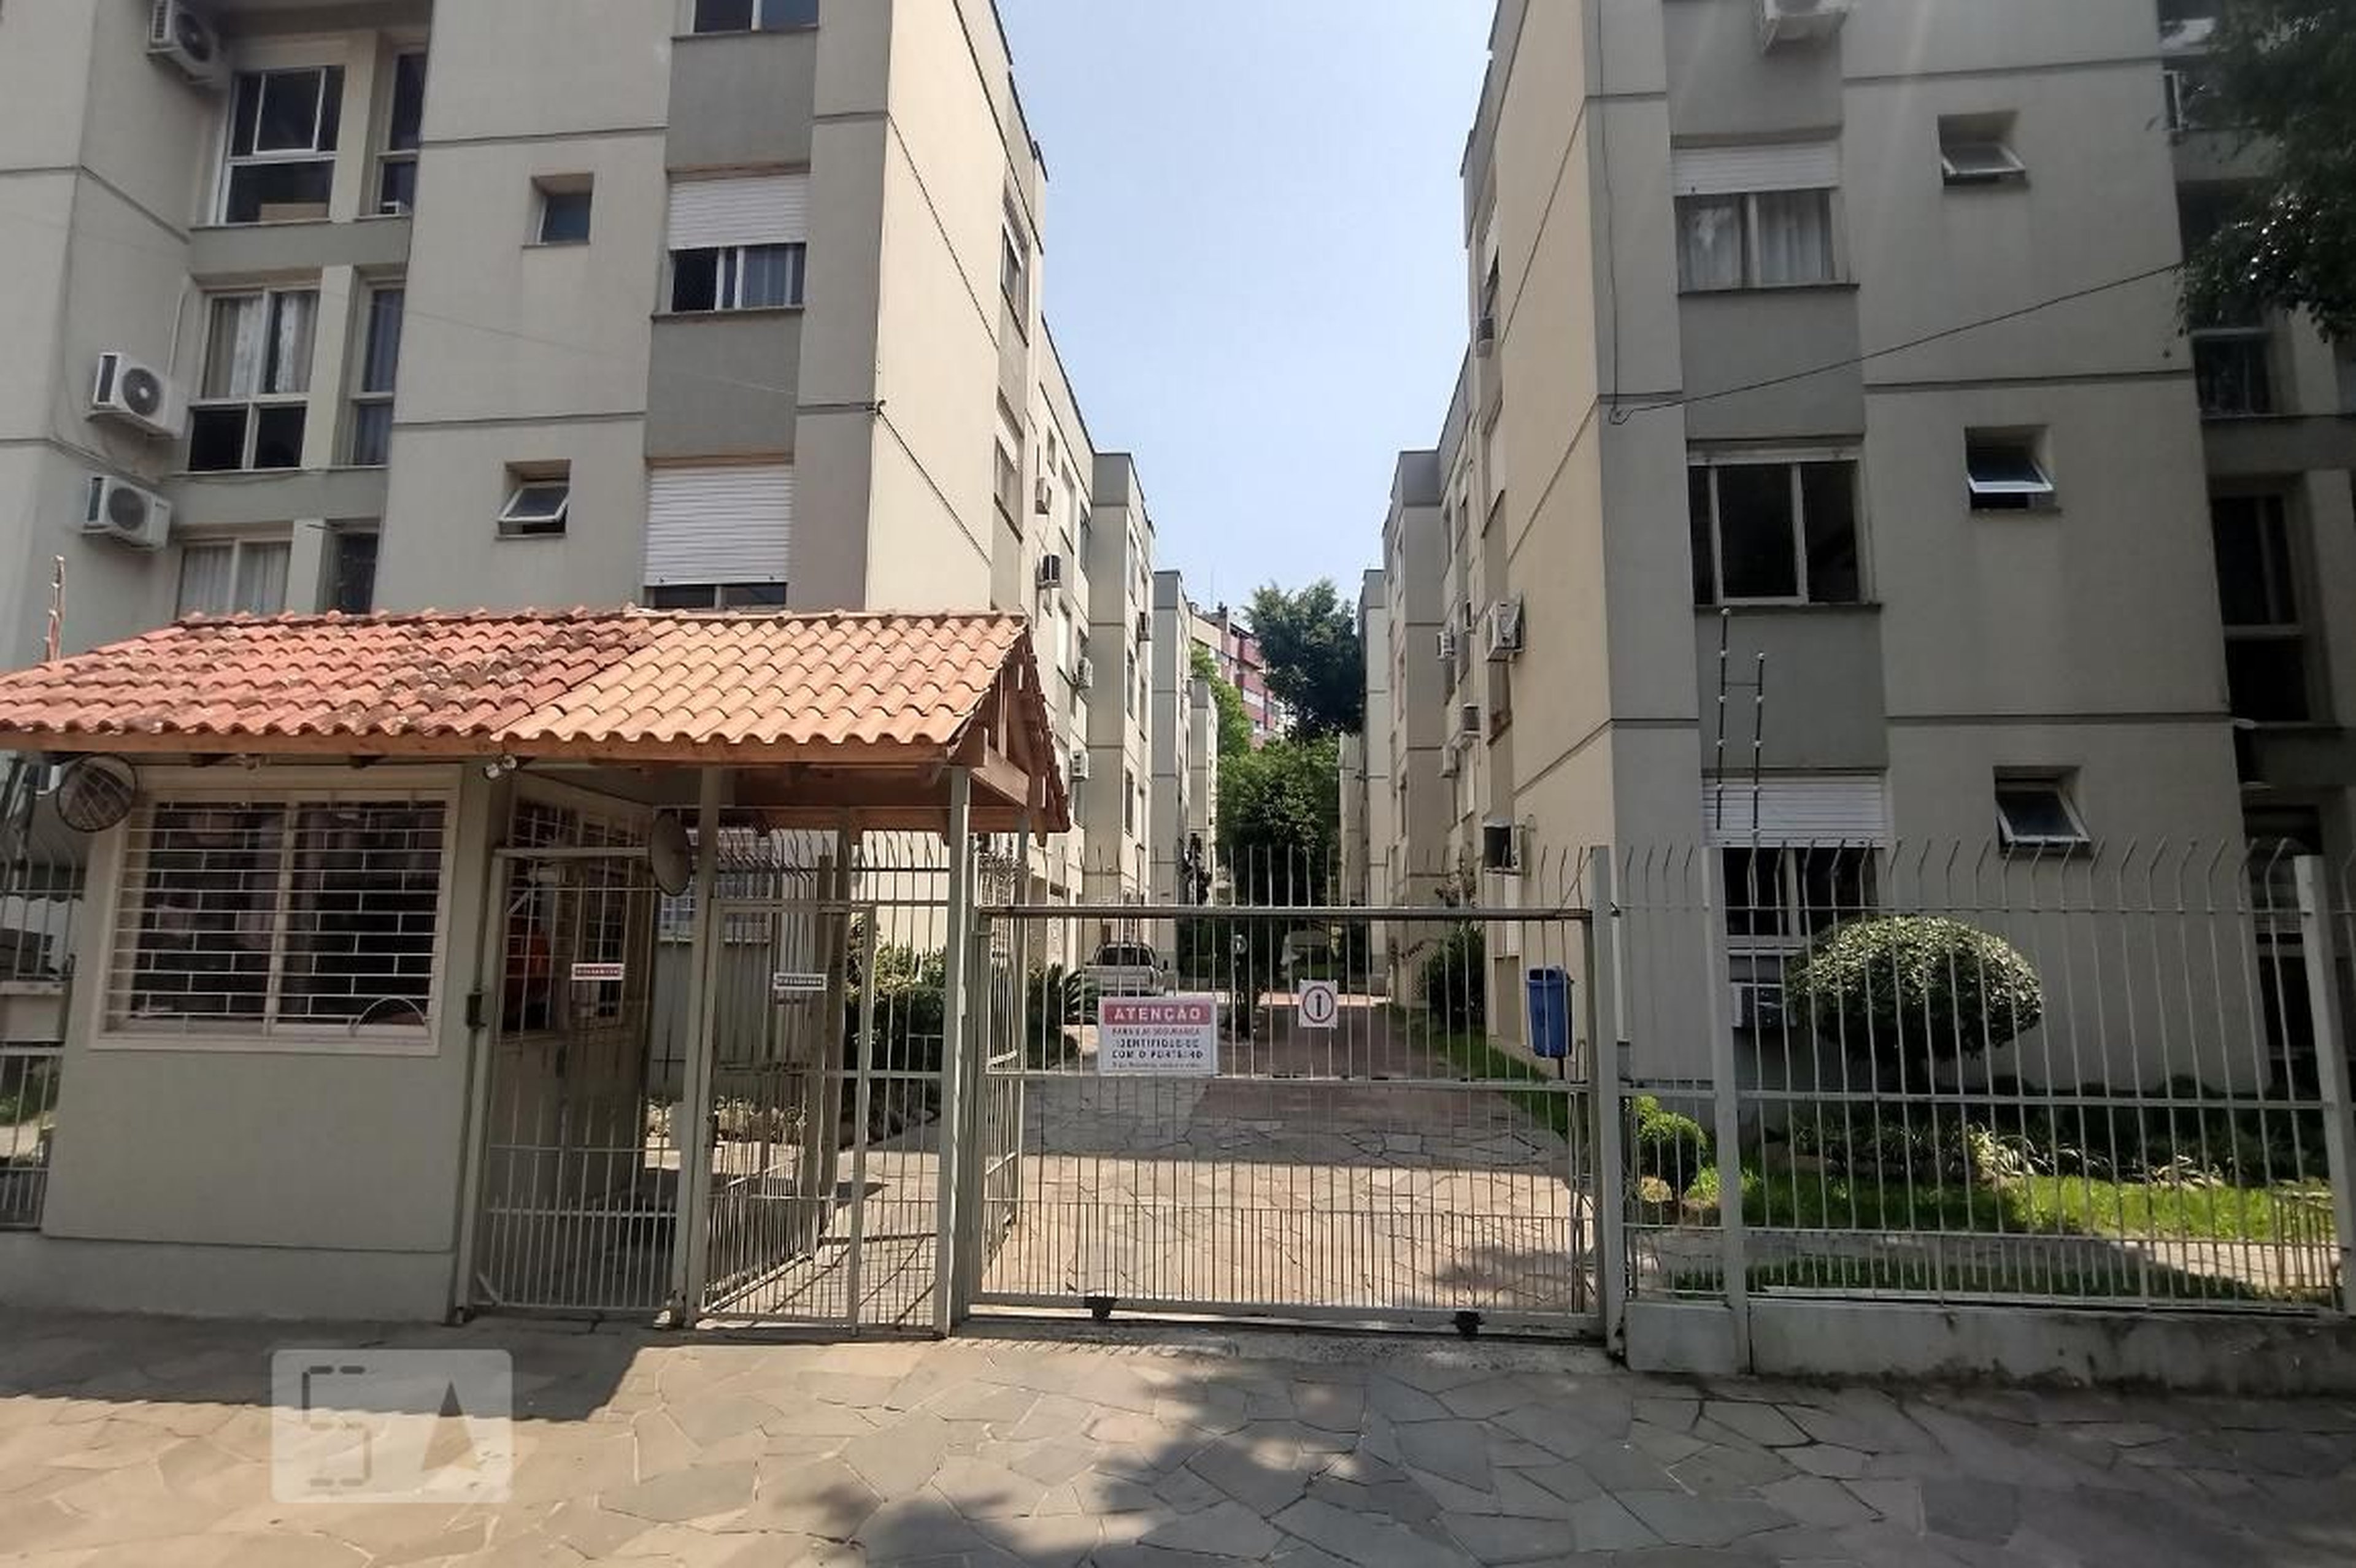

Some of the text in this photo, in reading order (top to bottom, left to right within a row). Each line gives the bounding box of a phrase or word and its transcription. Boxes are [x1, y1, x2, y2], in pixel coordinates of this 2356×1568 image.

[1112, 1050, 1204, 1059] COM O PORTEIRO
